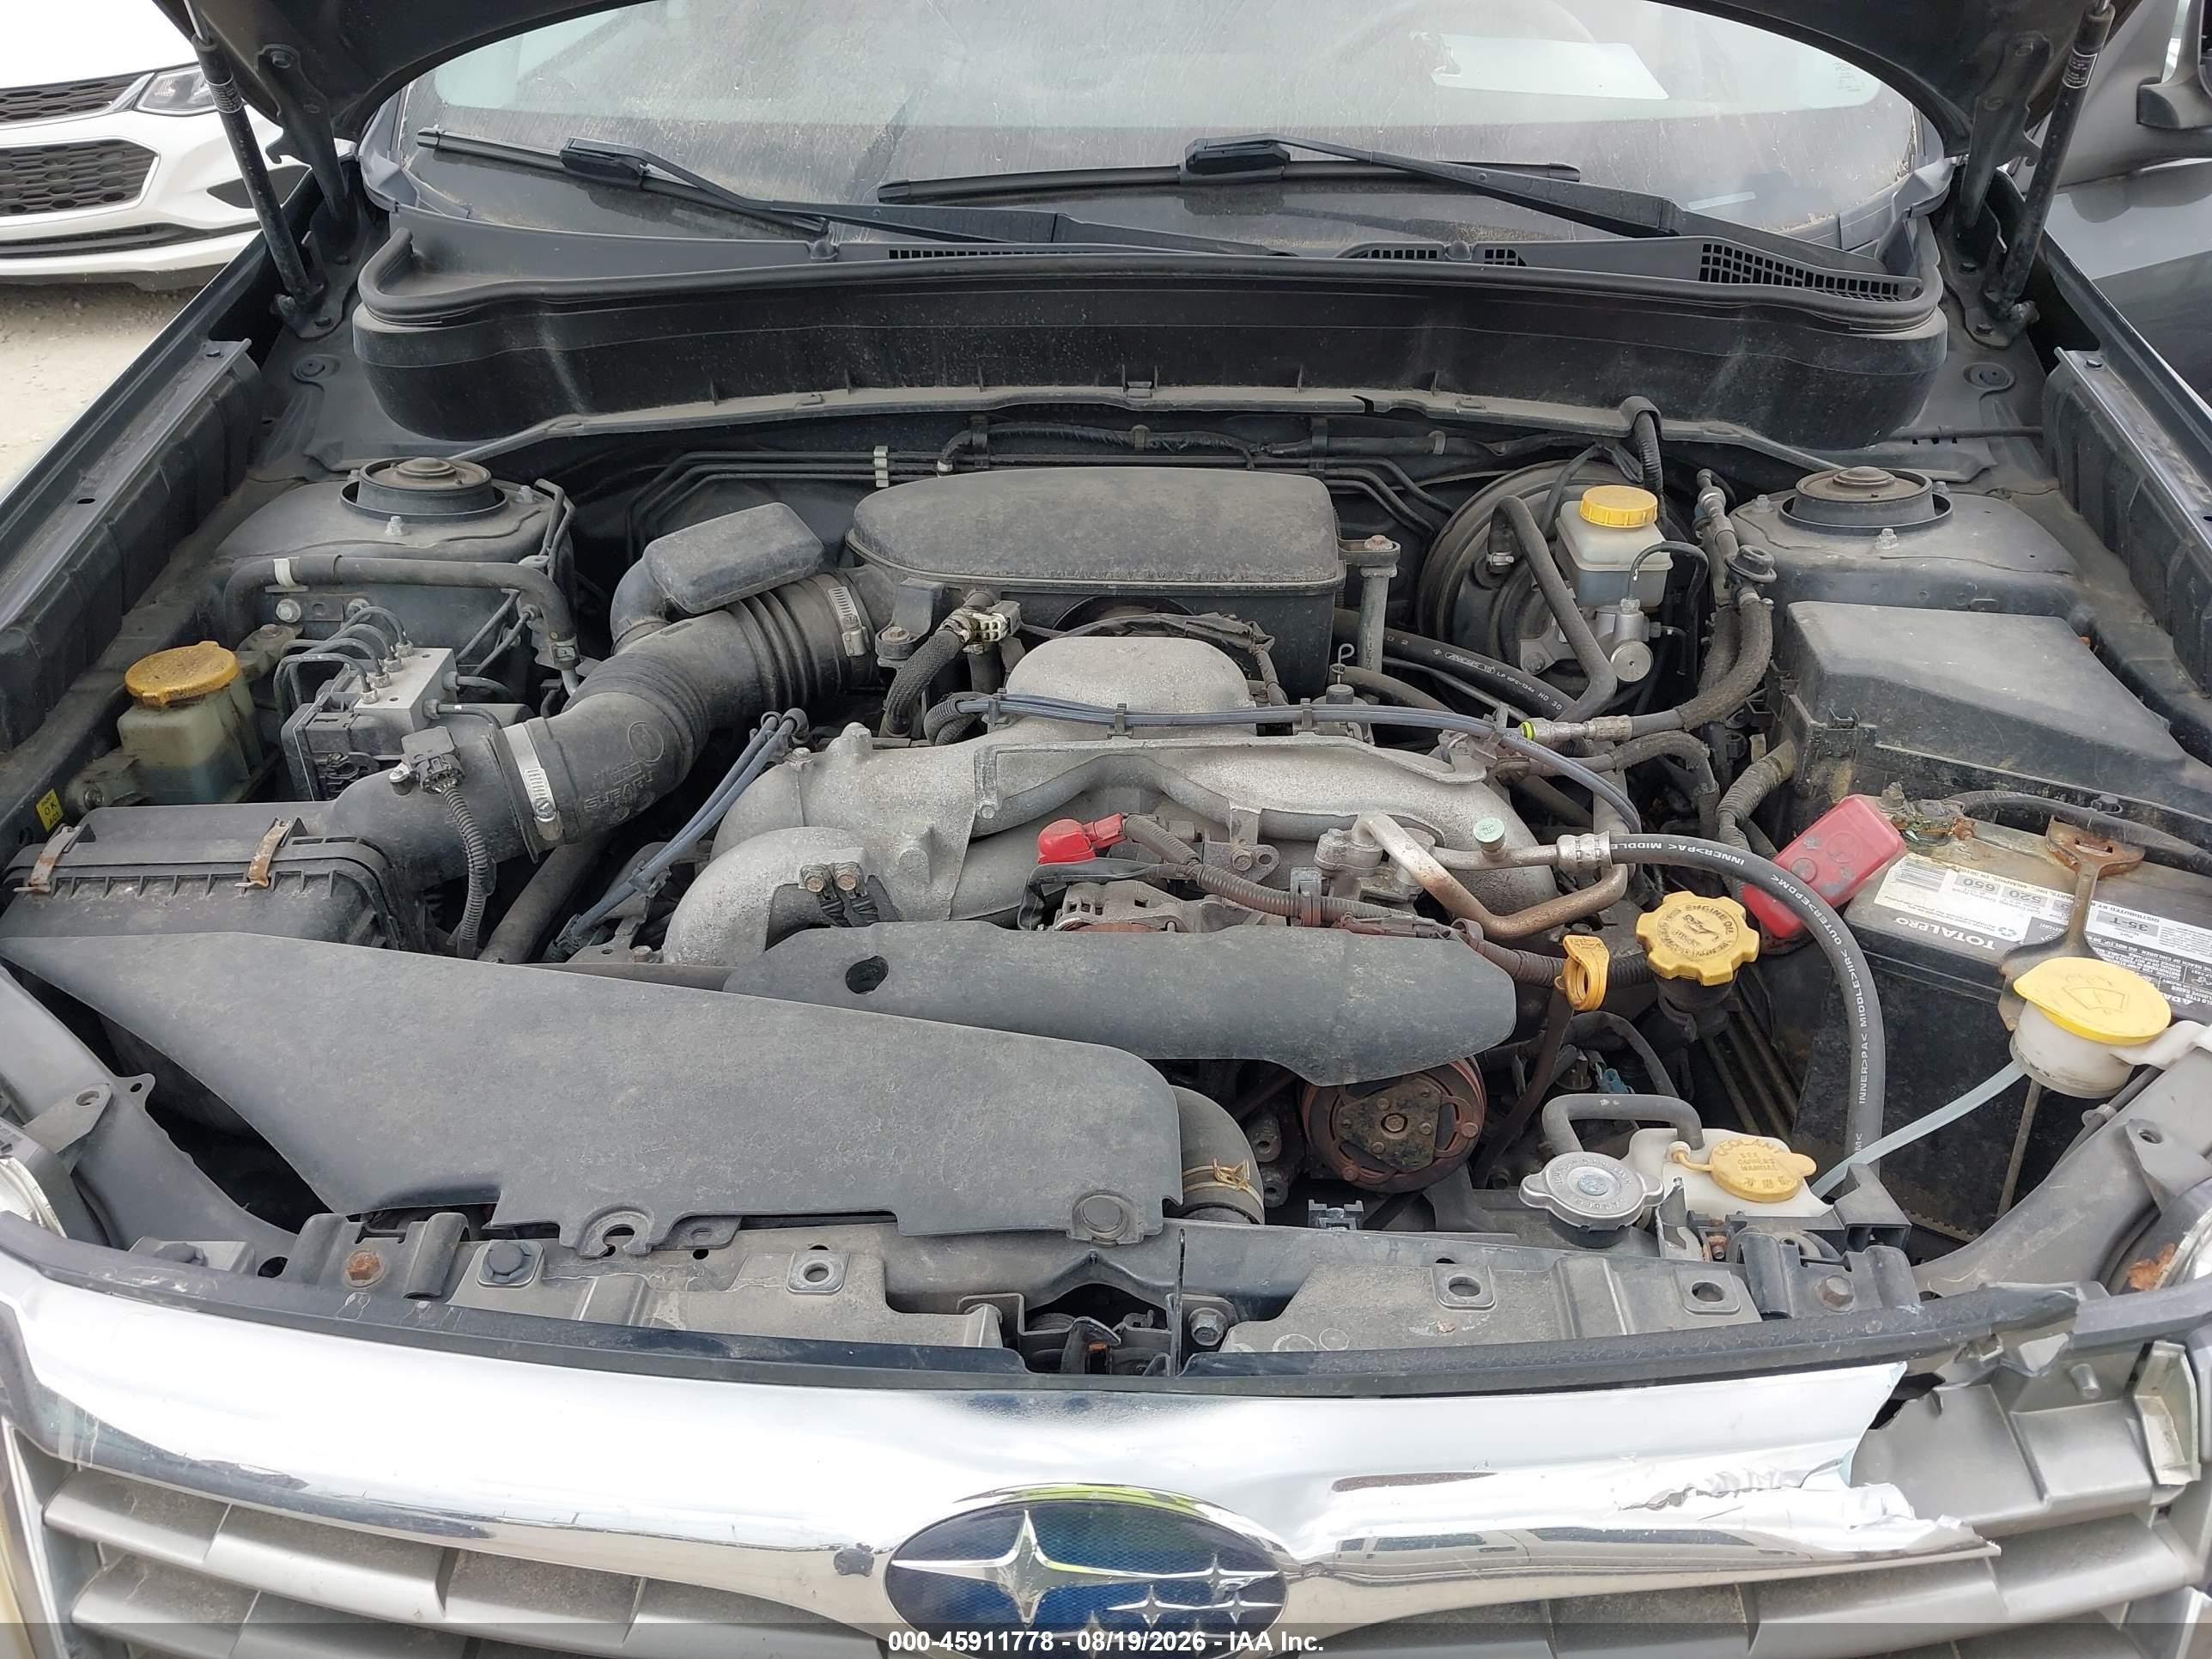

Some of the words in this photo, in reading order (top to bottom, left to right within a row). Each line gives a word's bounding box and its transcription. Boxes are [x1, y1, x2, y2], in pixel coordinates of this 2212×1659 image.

[1962, 877, 1995, 892] 650
[2008, 889, 2042, 903] 520
[2108, 915, 2148, 932] 35-T
[1894, 915, 1996, 950] TOTALPRO
